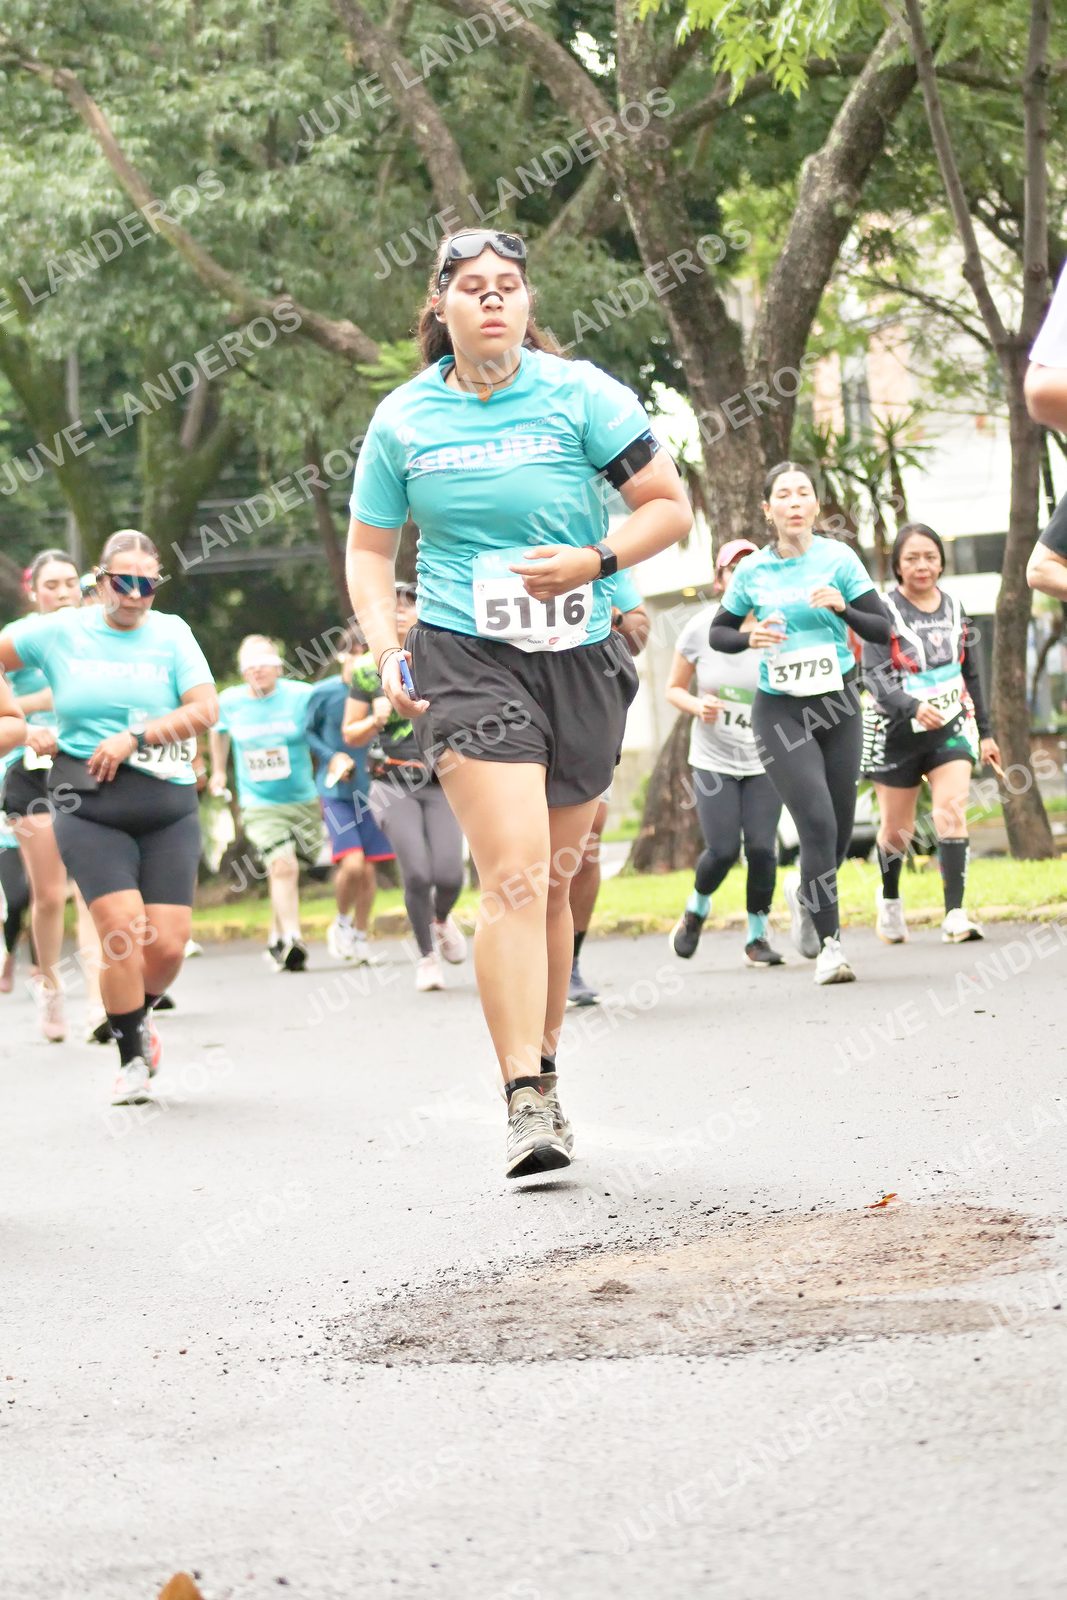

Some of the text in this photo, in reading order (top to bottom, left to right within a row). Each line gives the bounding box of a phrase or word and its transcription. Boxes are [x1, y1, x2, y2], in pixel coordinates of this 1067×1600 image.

[485, 593, 586, 631] 5116
[773, 657, 834, 684] 3779
[722, 710, 752, 730] 14
